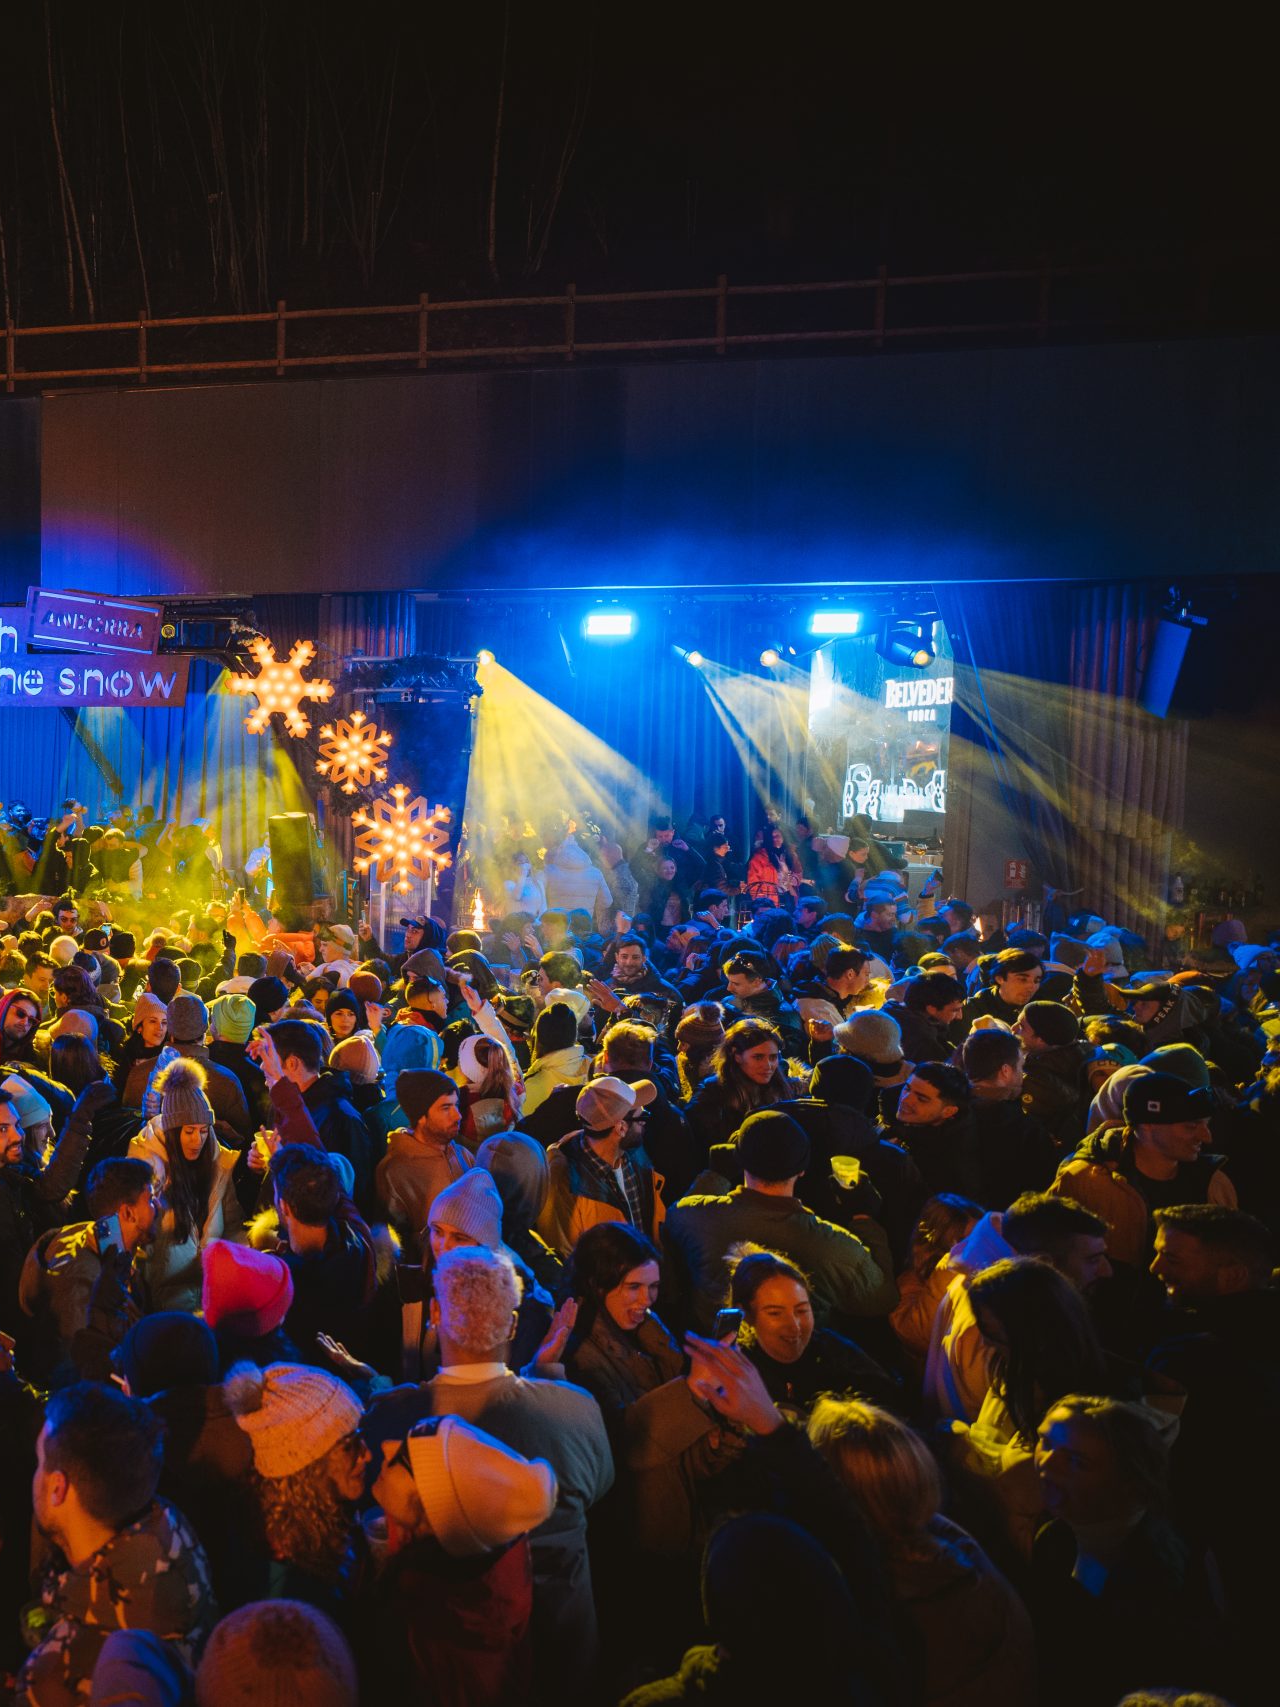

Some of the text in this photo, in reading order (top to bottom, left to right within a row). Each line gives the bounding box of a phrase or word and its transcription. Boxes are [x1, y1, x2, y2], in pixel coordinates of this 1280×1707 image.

[41, 610, 144, 640] ANDORRA
[58, 668, 177, 699] snow
[907, 709, 936, 722] VODKA
[1153, 1000, 1175, 1024] PEAK
